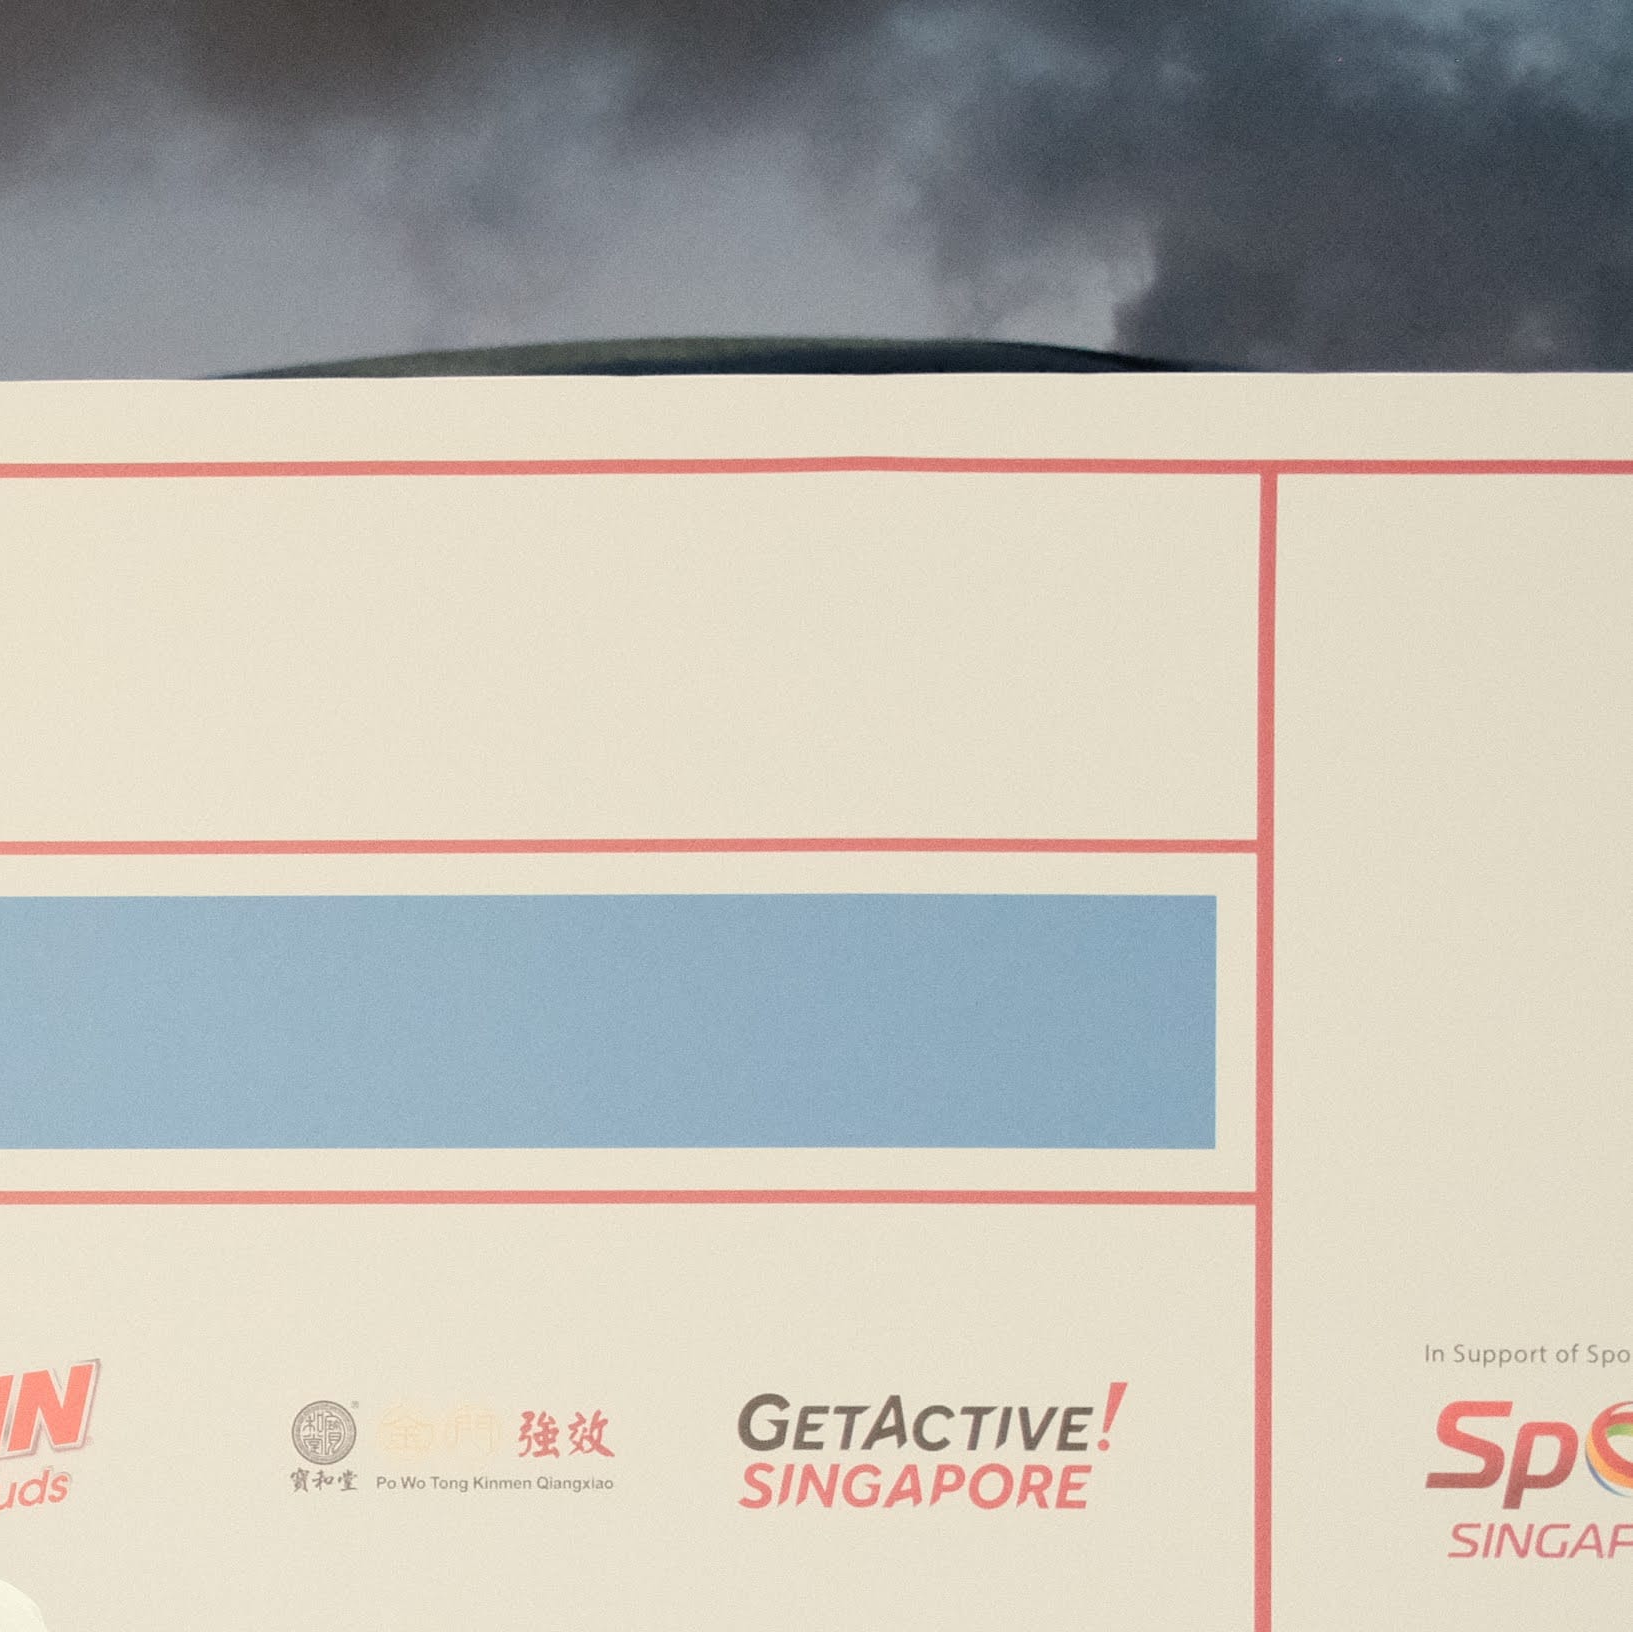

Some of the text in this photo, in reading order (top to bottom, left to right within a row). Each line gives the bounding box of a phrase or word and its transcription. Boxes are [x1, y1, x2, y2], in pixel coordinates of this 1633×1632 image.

[1425, 1345, 1444, 1363] In
[1453, 1345, 1546, 1368] Support
[1555, 1344, 1579, 1363] of
[376, 1475, 614, 1494] Po Wo Tong Kinmen Qiangxiao
[738, 1462, 1093, 1511] SINGAPORE
